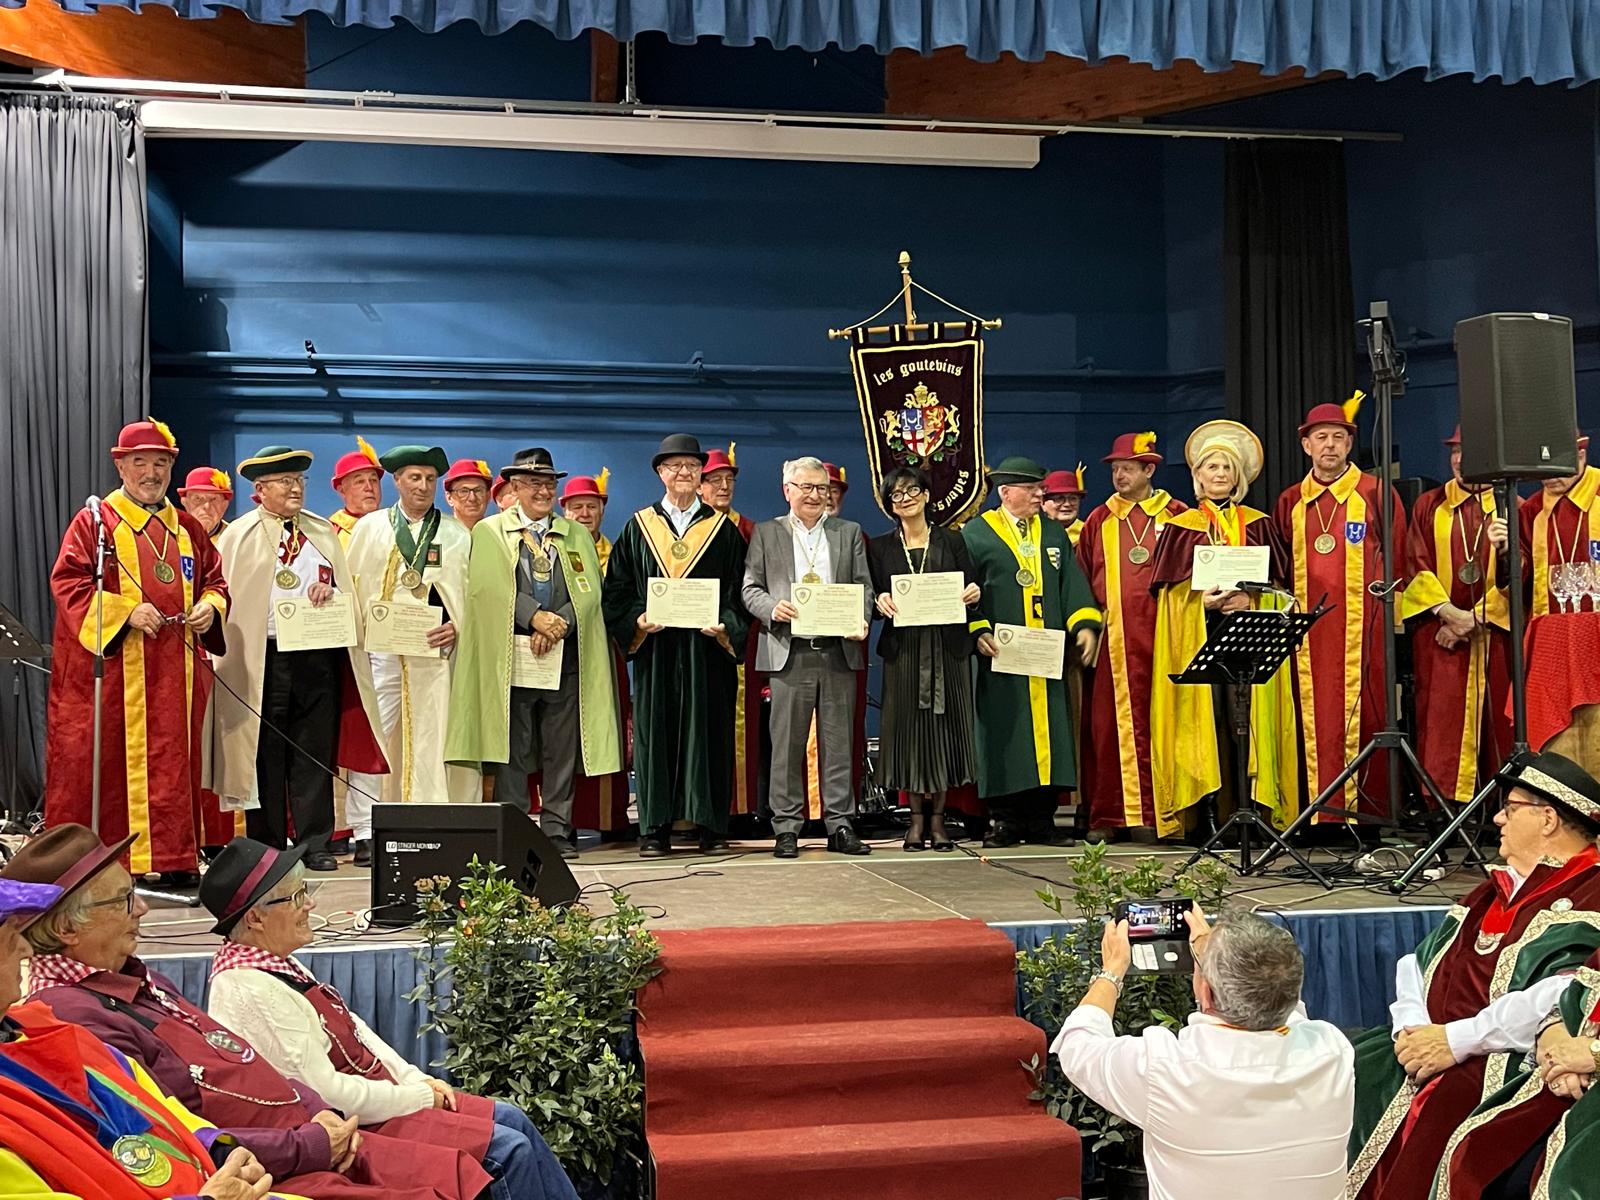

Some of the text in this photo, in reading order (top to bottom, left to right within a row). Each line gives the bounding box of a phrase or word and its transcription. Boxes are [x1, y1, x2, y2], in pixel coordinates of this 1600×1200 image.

[873, 358, 963, 386] les goutevins
[945, 469, 970, 507] papes
